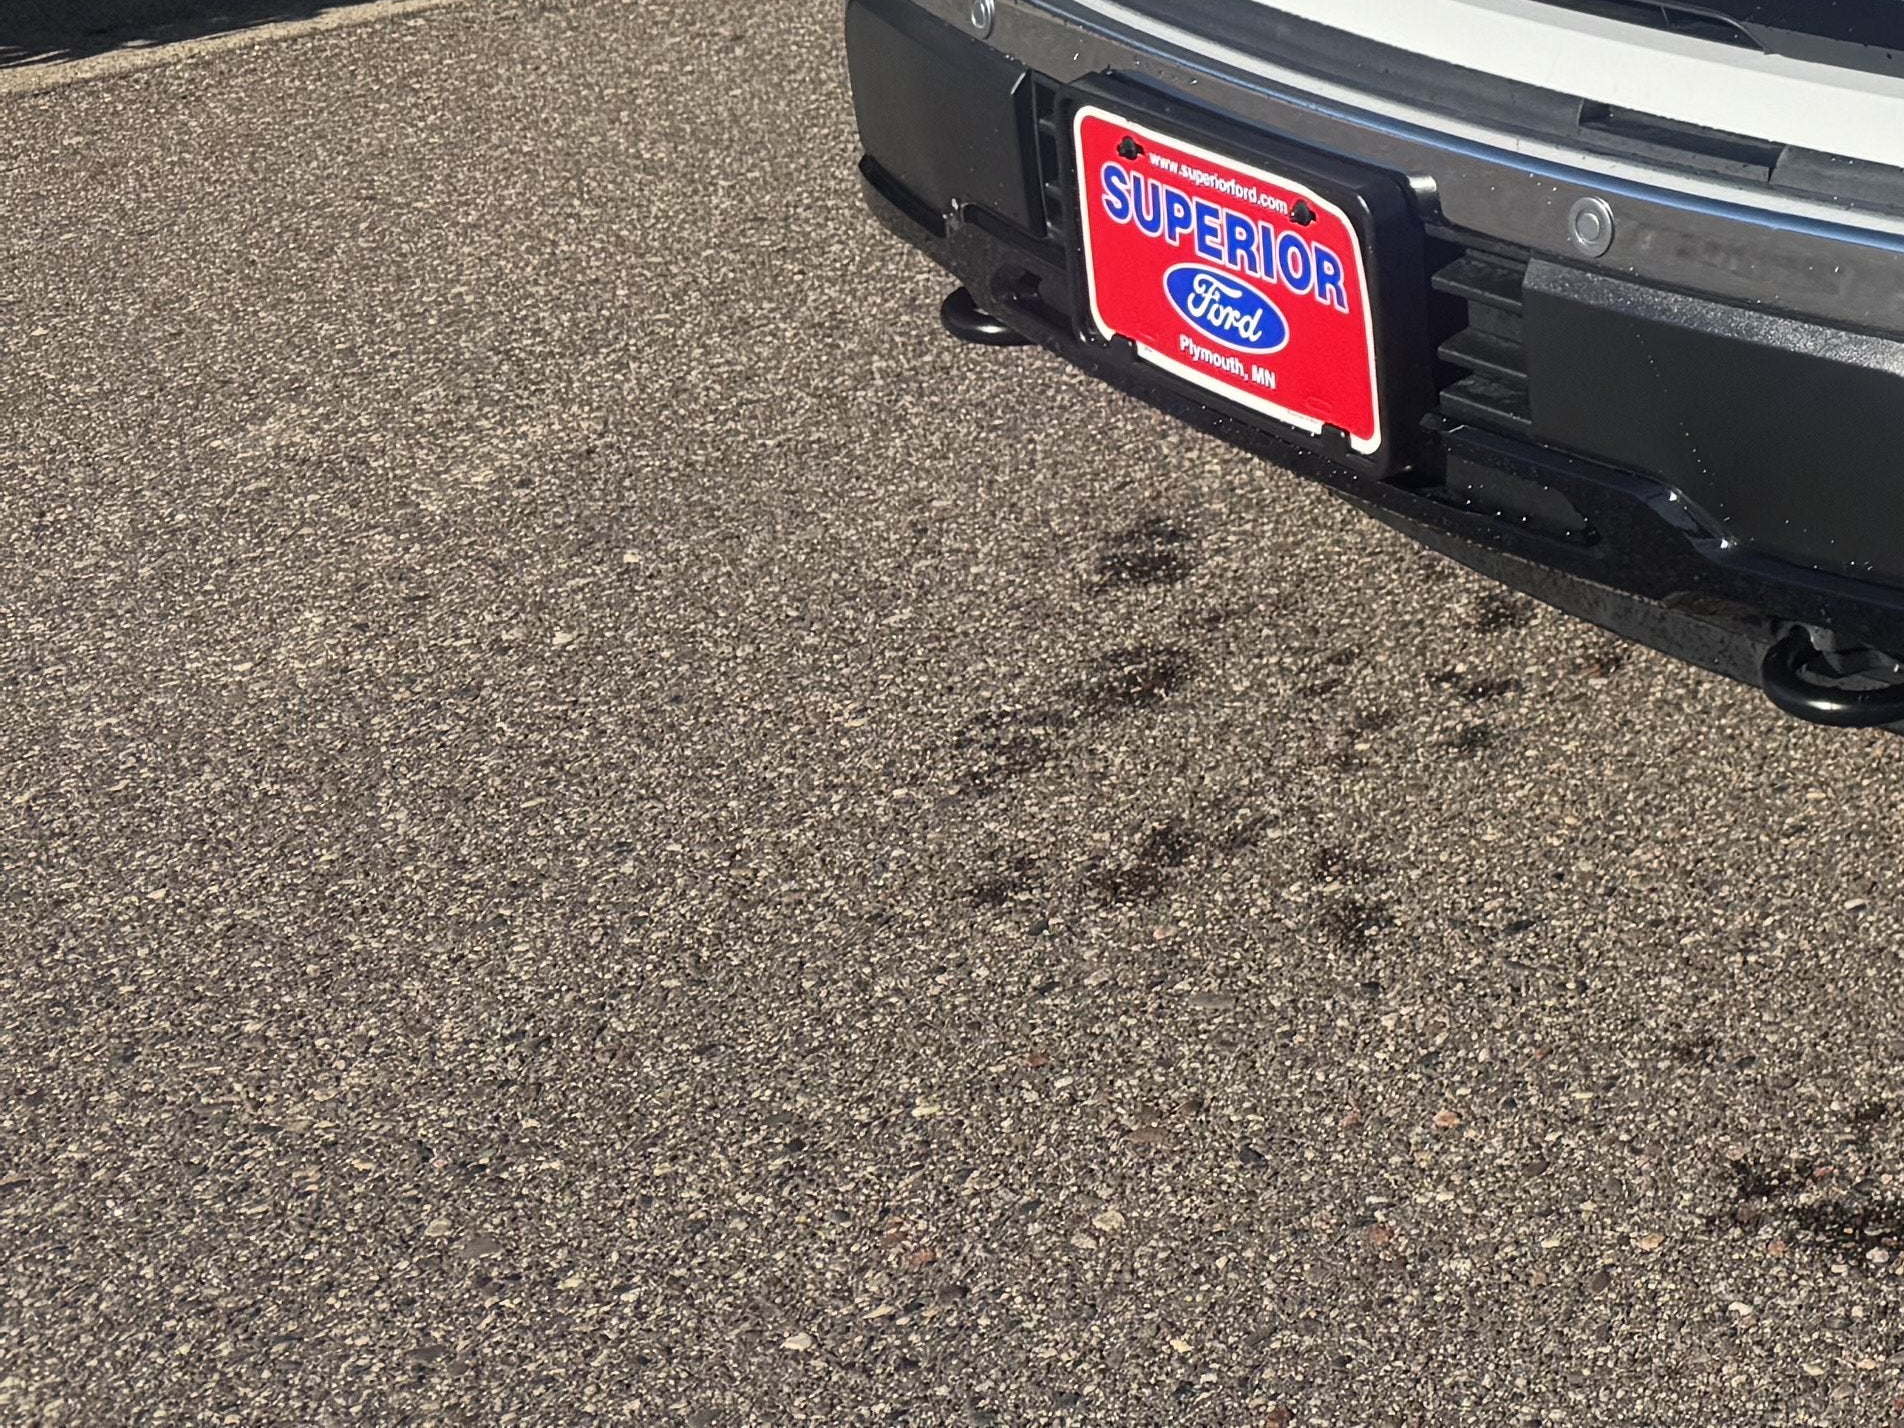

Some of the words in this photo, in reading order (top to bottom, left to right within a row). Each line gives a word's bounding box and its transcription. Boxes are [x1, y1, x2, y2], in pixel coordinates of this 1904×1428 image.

[1149, 153, 1289, 213] www.superiorford.com
[1102, 161, 1350, 314] SUPERIOR
[1186, 273, 1264, 344] Ford
[1178, 333, 1250, 382] Plymouth,
[1251, 362, 1277, 390] MN
